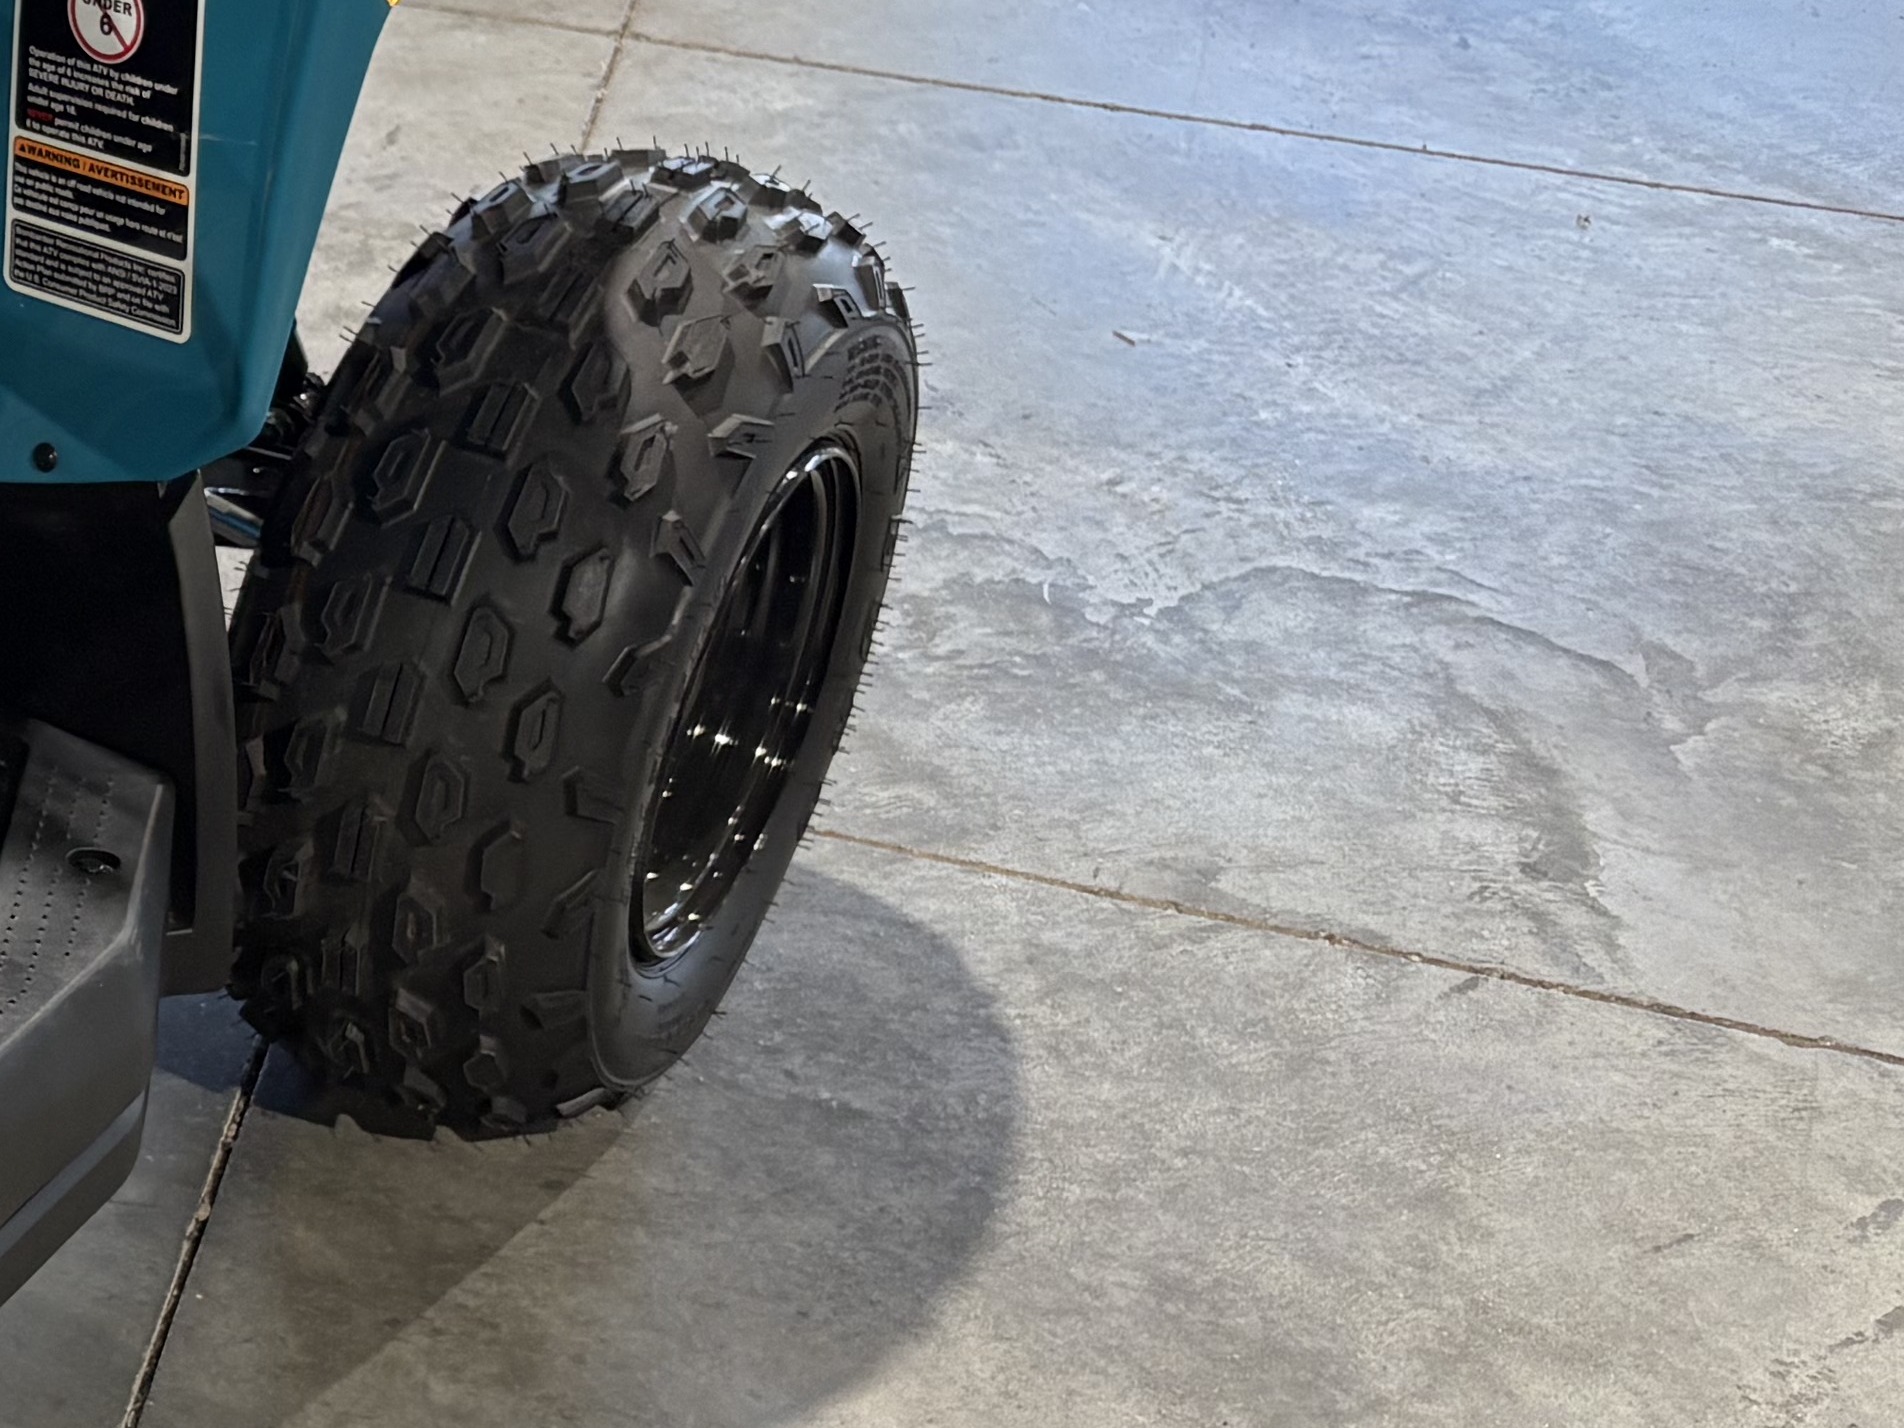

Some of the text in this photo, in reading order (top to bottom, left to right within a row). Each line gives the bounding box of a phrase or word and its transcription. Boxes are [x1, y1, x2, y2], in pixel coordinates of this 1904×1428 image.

[100, 12, 113, 35] 6
[26, 145, 80, 168] WARNING
[88, 162, 183, 199] AVERTISSEMENT
